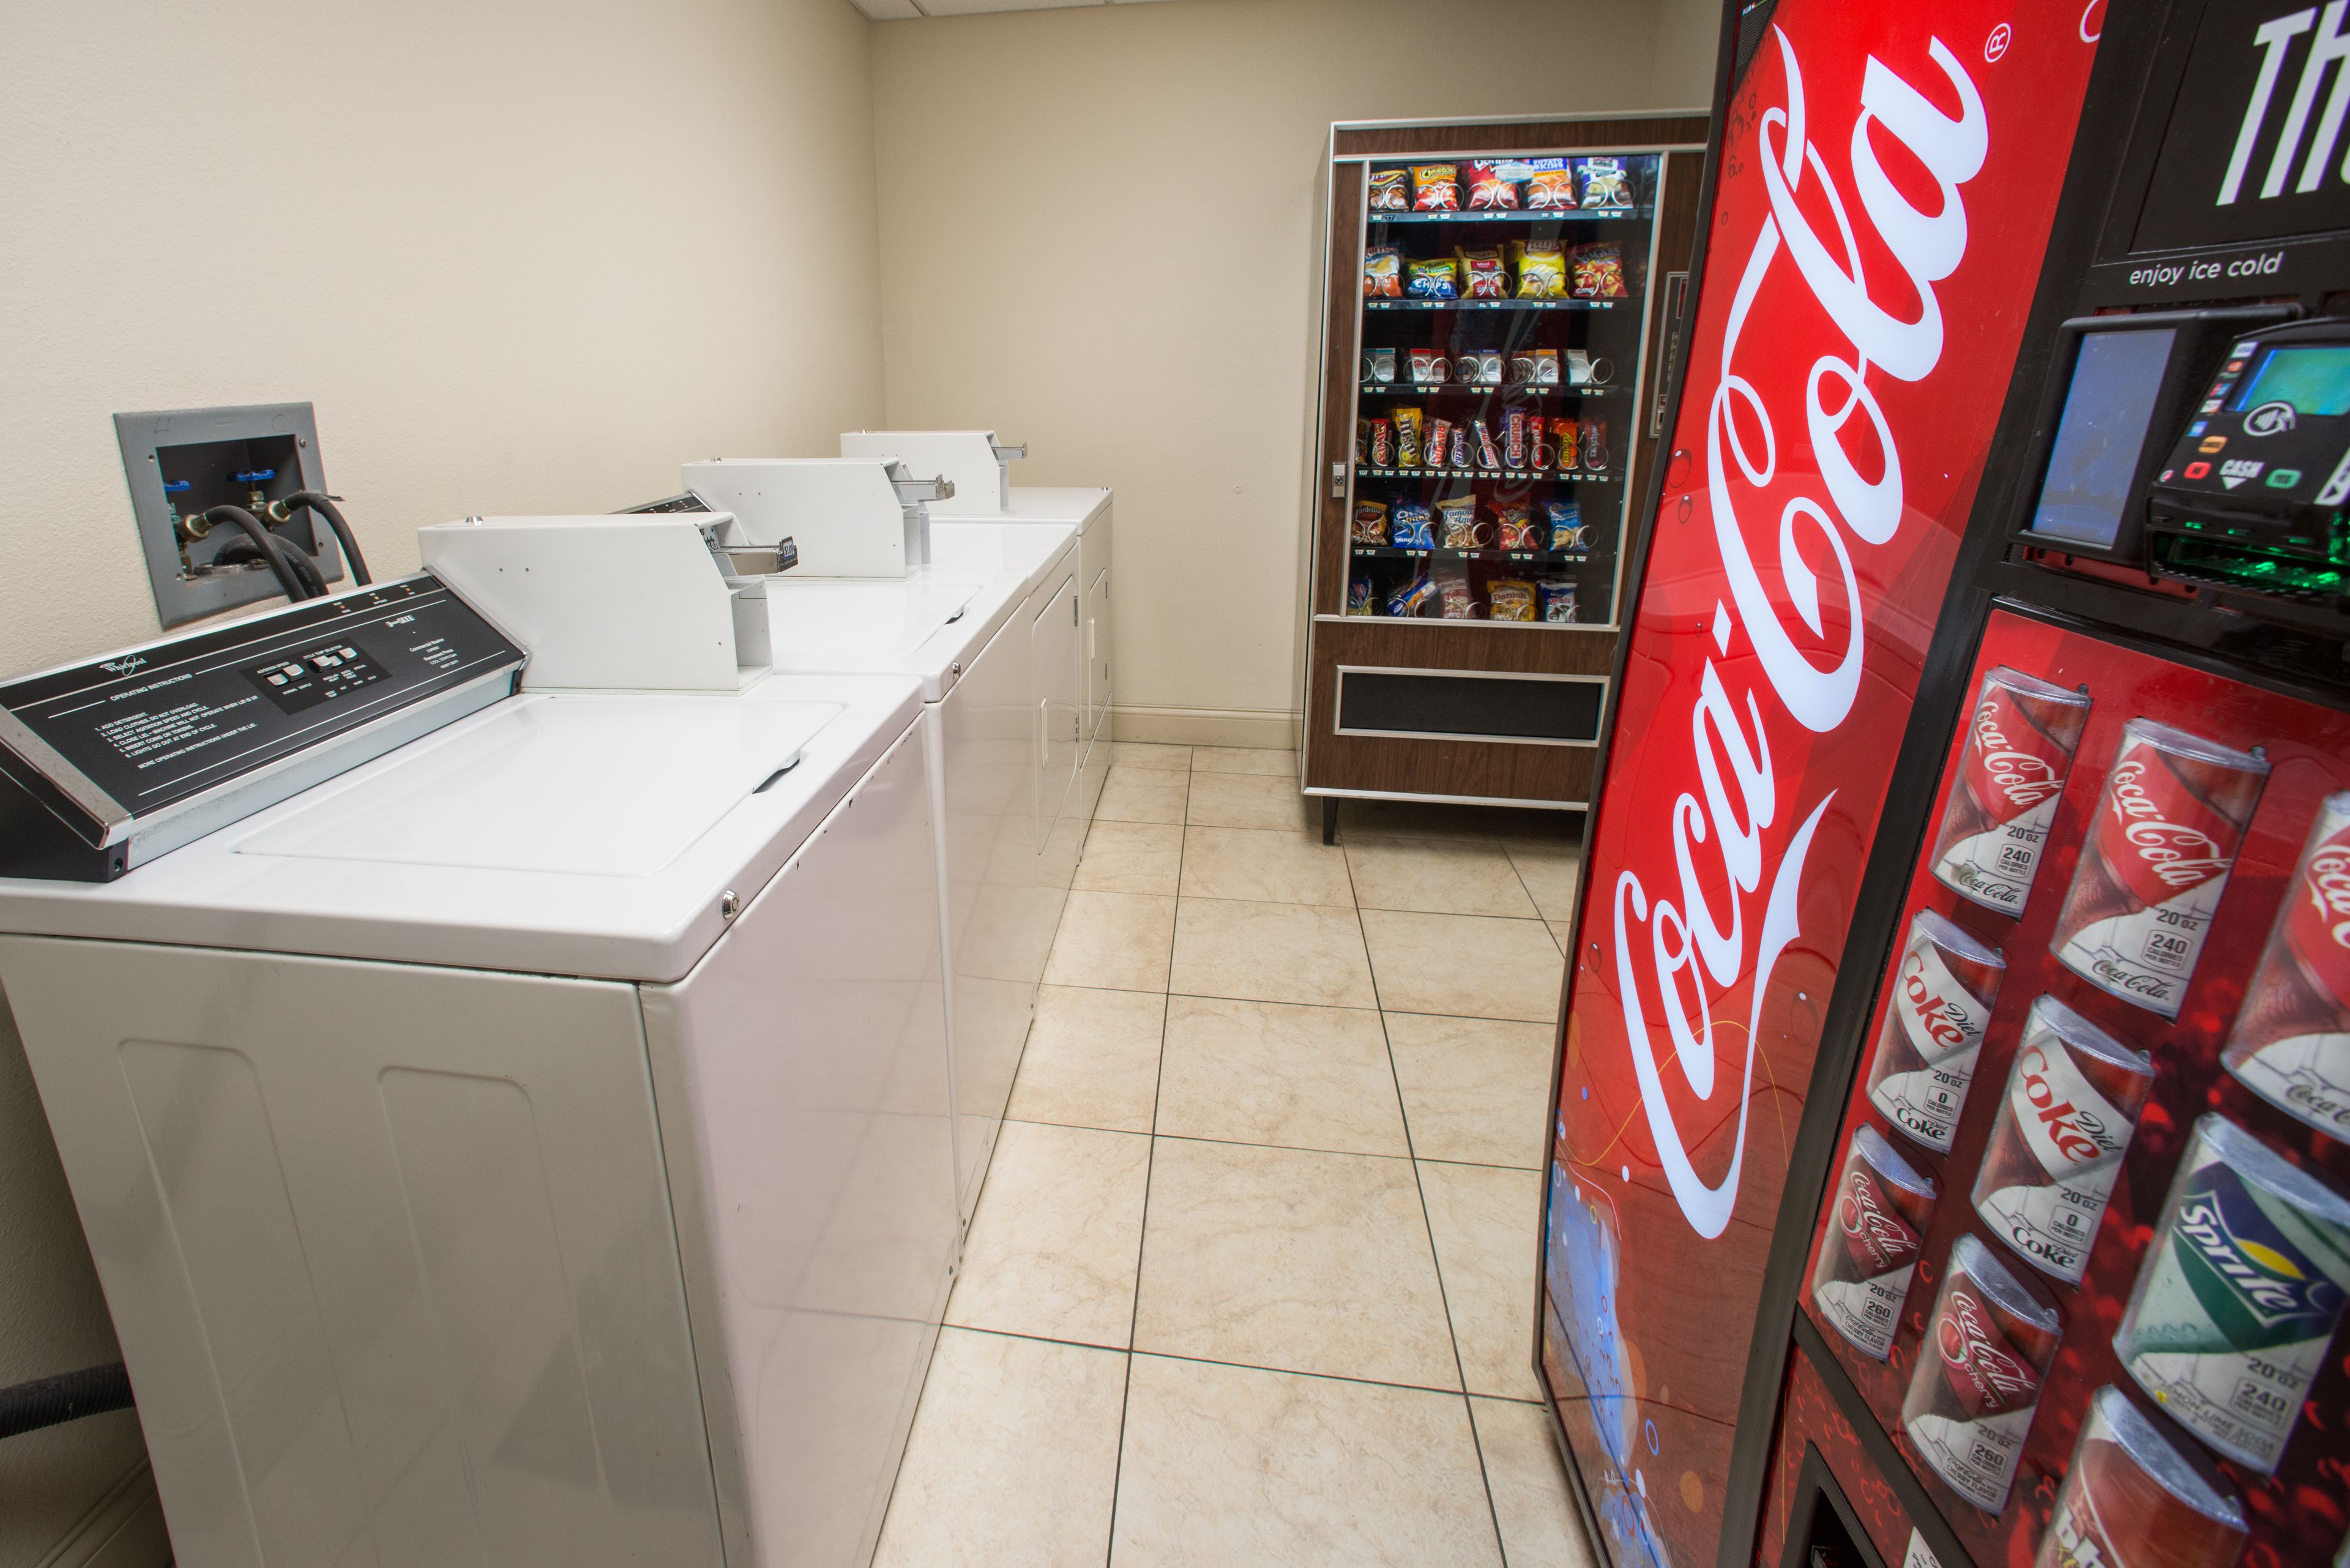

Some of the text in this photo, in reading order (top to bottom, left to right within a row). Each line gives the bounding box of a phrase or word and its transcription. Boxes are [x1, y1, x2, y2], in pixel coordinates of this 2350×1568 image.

[1420, 166, 1456, 180] Cheetos
[2129, 251, 2284, 286] enjoy ice cold
[1512, 415, 1521, 457] CRUNCH
[2220, 460, 2264, 478] CASH
[1493, 591, 1527, 600] Danish
[1614, 23, 1990, 1239] Coca-Cola
[104, 657, 147, 673] Whirlpool
[110, 673, 193, 701] OPERATING INSTRUCTIONS
[113, 730, 135, 740] SELECT
[135, 721, 163, 733] AGITATION
[162, 715, 181, 723] SPEED
[114, 712, 149, 725] DETERGENT.
[119, 736, 140, 745] CLOSE
[152, 723, 177, 734] MACHINE
[200, 707, 225, 717] OPERATE
[124, 741, 146, 750] INSERT
[145, 735, 164, 744] COINS
[130, 746, 152, 756] LIGHTS
[138, 760, 155, 769] MORE
[154, 749, 186, 763] OPERATING
[185, 736, 222, 752] INSTRUCTIONS
[220, 730, 239, 738] UNDER
[1974, 701, 2064, 805] Coca-Cola
[2007, 826, 2024, 840] 20
[2110, 761, 2232, 886] Coca-Cola
[2001, 859, 2028, 870] CALORIES
[2003, 848, 2031, 864] 240
[1960, 871, 2023, 903] Coca-Cola
[2157, 909, 2179, 925] 20
[2147, 946, 2183, 961] CALORIES
[2151, 934, 2187, 954] 240
[2158, 958, 2182, 967] BOTTLE
[2092, 959, 2176, 999] Coca-Cola
[1903, 951, 1982, 1048] Diet Coke
[1933, 1070, 1950, 1084] 20
[1928, 1099, 1953, 1112] CALORIES
[1938, 1092, 1947, 1103] 0
[2020, 1045, 2122, 1163] Diet Coke
[1935, 1108, 1953, 1116] BOTTLE
[1897, 1107, 1948, 1140] Diet Coke
[2061, 1188, 2081, 1203] 20
[1850, 1171, 1918, 1255] Coca-Cola
[2067, 1214, 2078, 1226] 0
[2053, 1220, 2086, 1237] CALORIES
[1859, 1231, 1888, 1268] cherry
[2012, 1226, 2077, 1268] Diet Coke
[2179, 1204, 2298, 1311] Sprite
[1870, 1283, 1885, 1297] 20
[1865, 1309, 1889, 1323] CALORIES
[1867, 1301, 1891, 1318] 260
[1845, 1321, 1885, 1346] CHERRY FLAVOR
[1950, 1291, 2038, 1394] Coca-Cola
[2247, 1357, 2275, 1378] 20
[1964, 1363, 1999, 1408] cherry
[2241, 1383, 2288, 1411] 240
[1978, 1424, 1996, 1441] 20
[1974, 1444, 2004, 1465] 260
[1947, 1464, 1997, 1499] CHERRY FLAVOR
